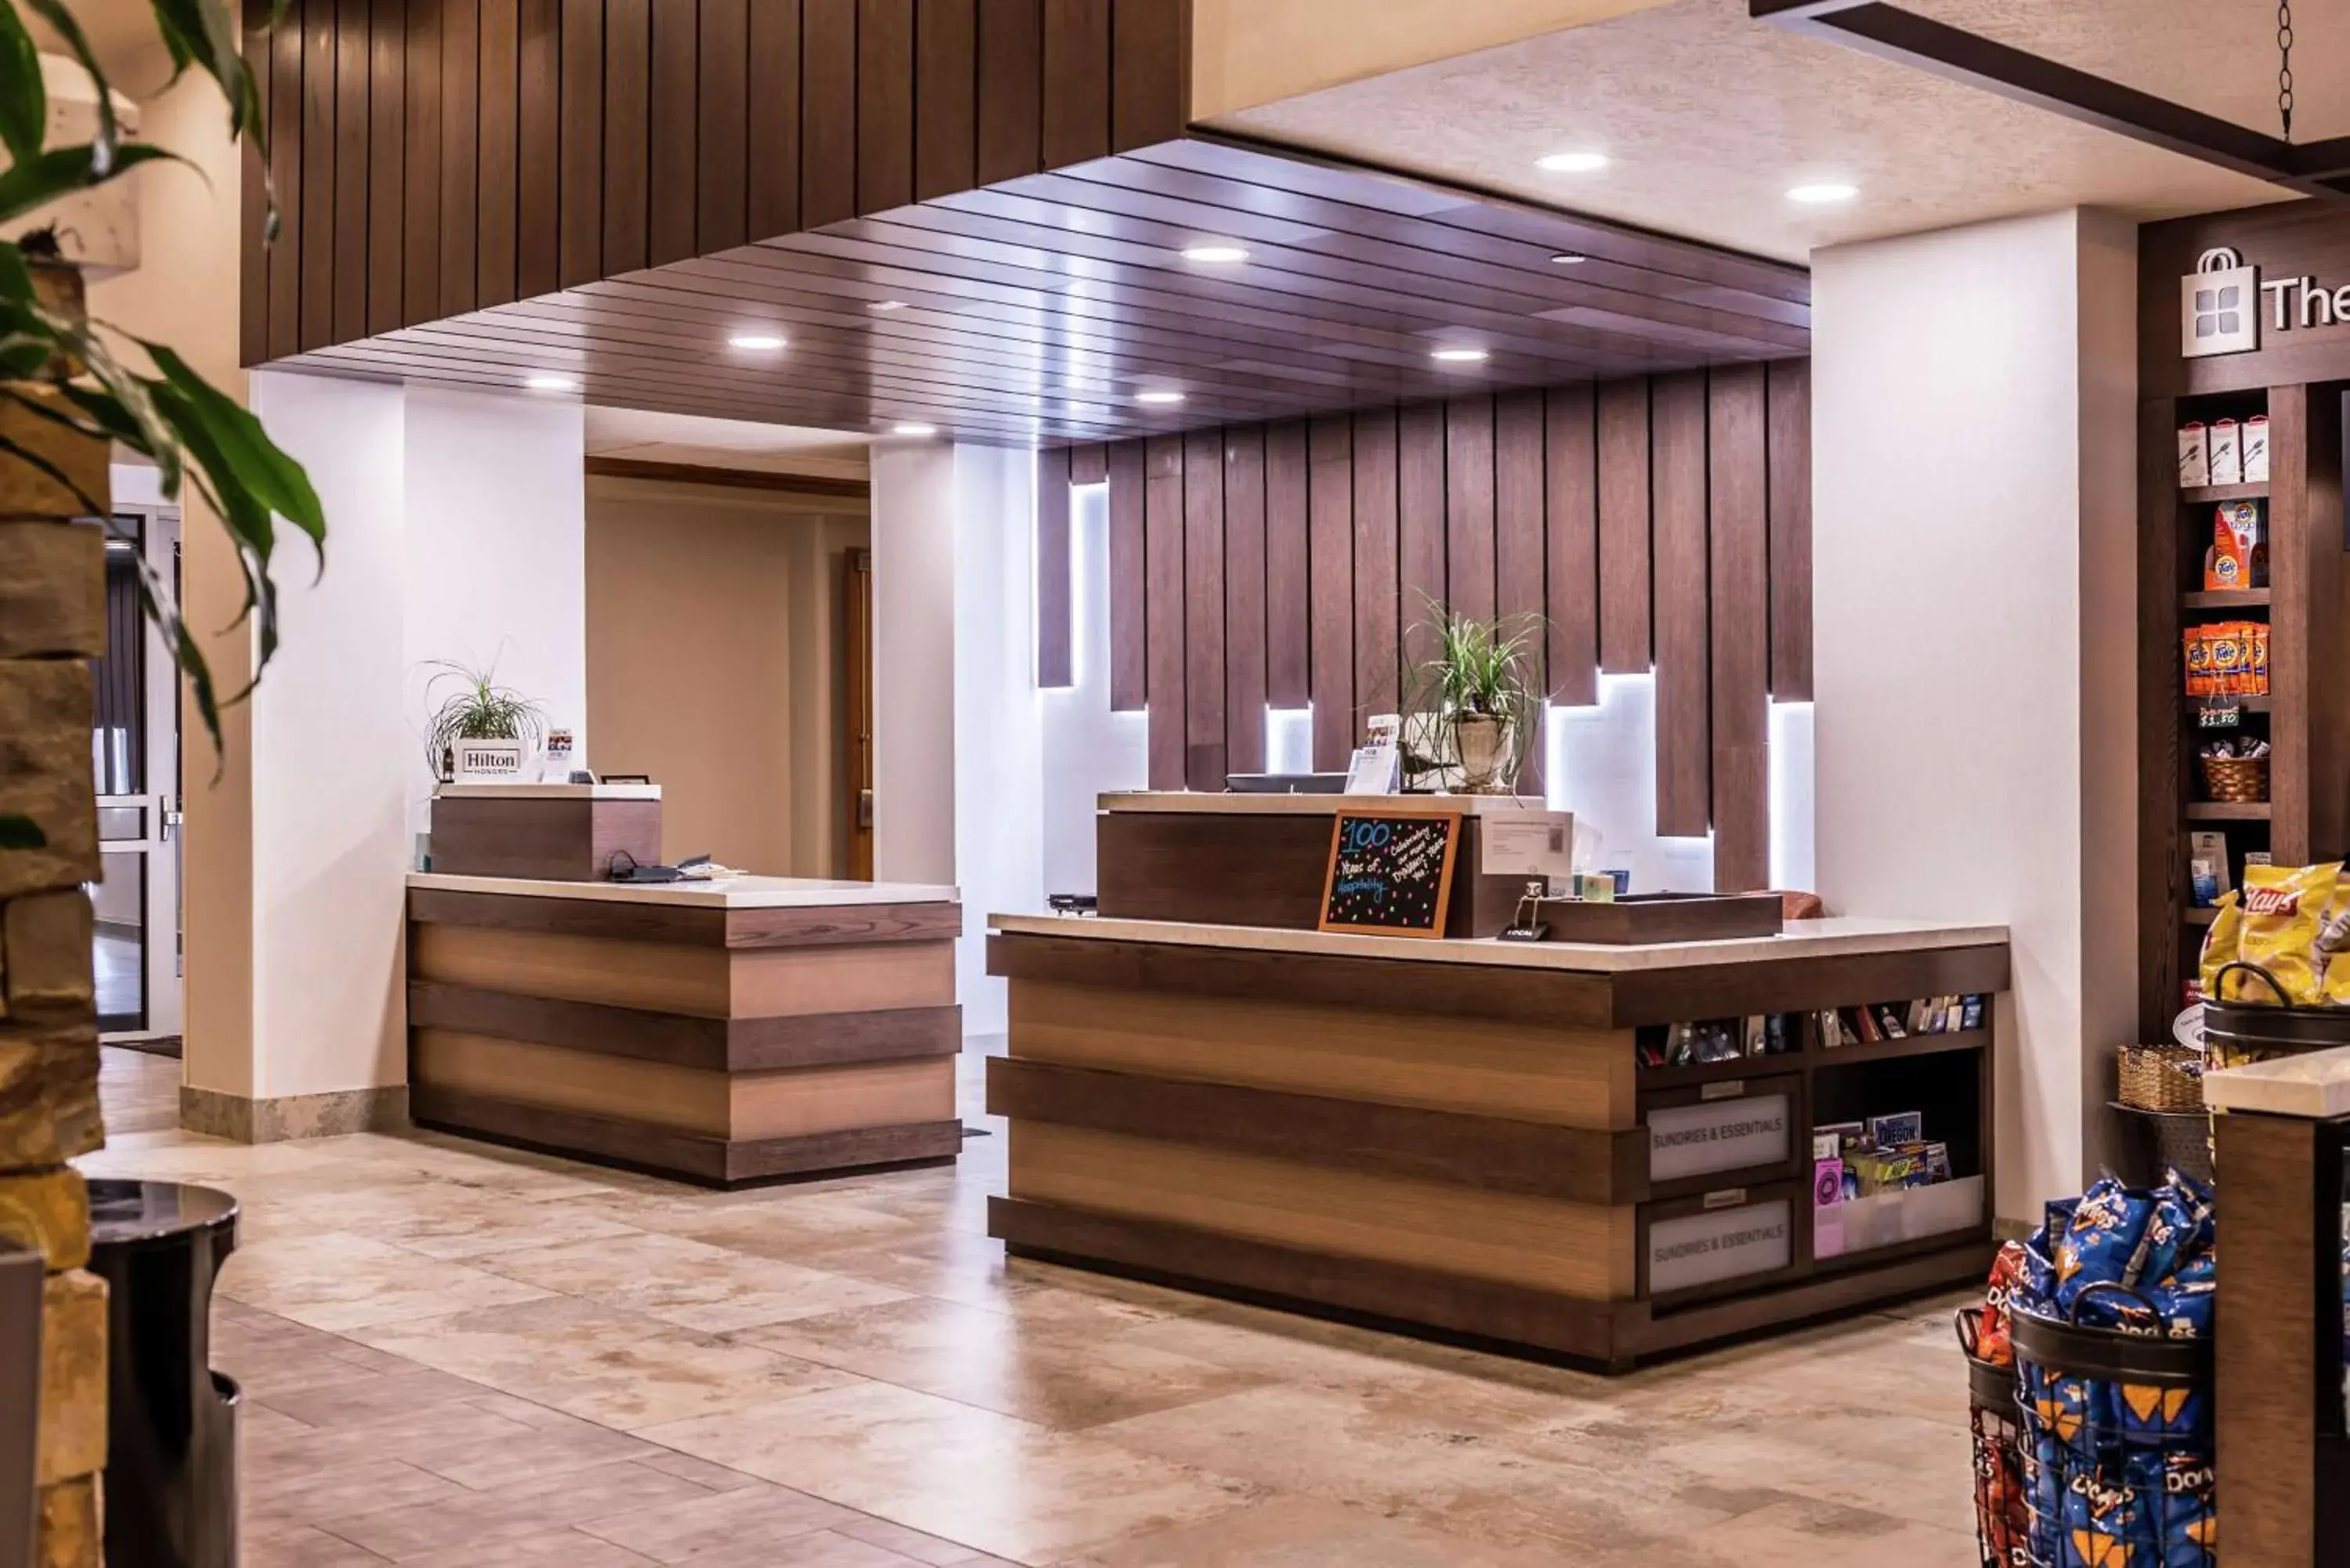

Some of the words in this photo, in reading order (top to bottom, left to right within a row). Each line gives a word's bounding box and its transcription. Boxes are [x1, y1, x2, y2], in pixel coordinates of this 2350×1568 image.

[2260, 276, 2350, 330] The
[468, 753, 515, 766] Hilton
[1341, 818, 1390, 853] 100
[1654, 1128, 1708, 1149] SUNDRIES
[1711, 1126, 1719, 1141] &
[1721, 1117, 1782, 1140] ESSENTIALS
[1723, 1223, 1786, 1249] ESSENTIALS
